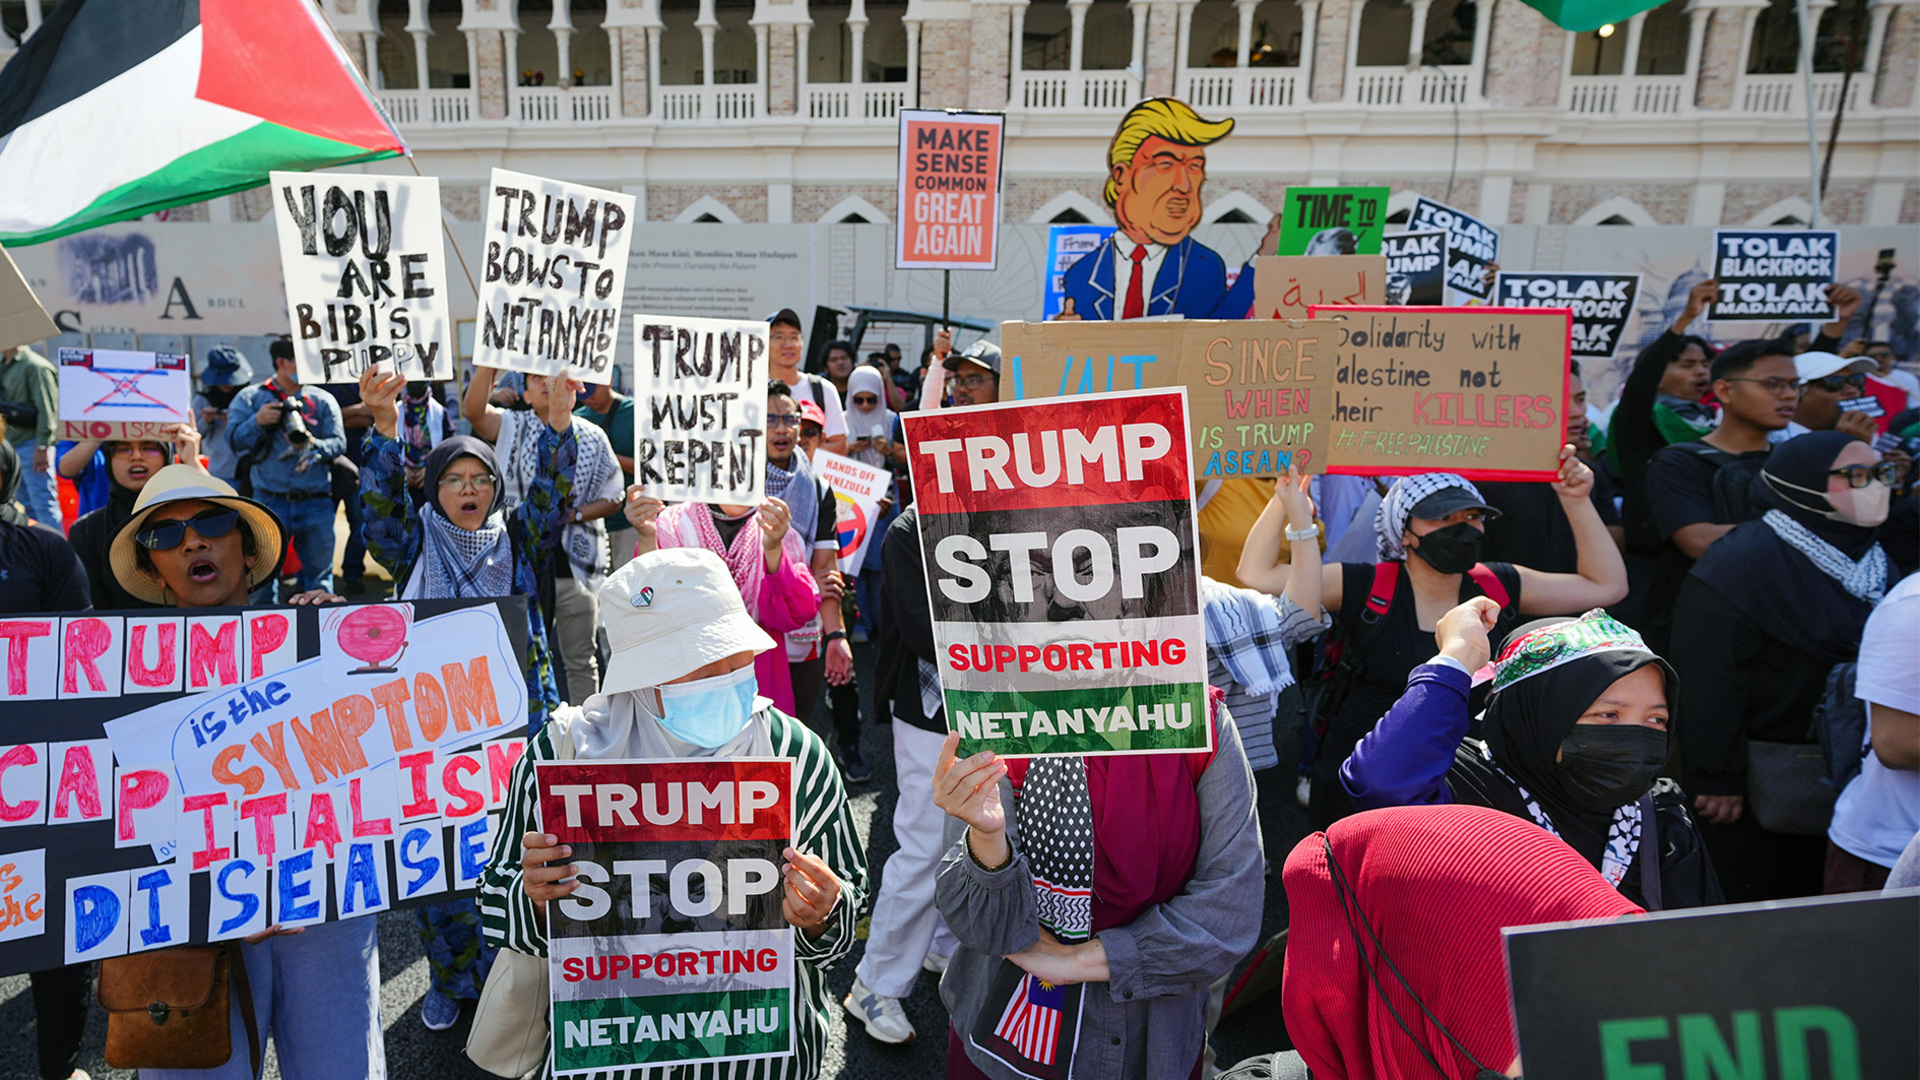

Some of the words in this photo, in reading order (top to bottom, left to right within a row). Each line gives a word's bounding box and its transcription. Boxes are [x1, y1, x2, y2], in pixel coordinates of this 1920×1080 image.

[917, 127, 990, 152] MAKE
[915, 153, 988, 174] SENSE
[914, 176, 987, 192] COMMON
[282, 185, 392, 260] YOU
[495, 186, 626, 260] TRUMP
[913, 192, 986, 223] GREAT
[1297, 194, 1352, 228] TIME
[1357, 198, 1377, 221] TO
[1417, 202, 1496, 249] TOLAK
[913, 224, 983, 255] AGAIN
[1721, 237, 1832, 258] TOLAK
[336, 253, 435, 300] ARE
[485, 241, 571, 291] BOWS
[573, 260, 615, 301] TO
[1720, 257, 1832, 277] BLACKROCK
[1504, 279, 1631, 300] TOLAK
[1715, 302, 1830, 315] MADAFAKA
[1719, 283, 1831, 303] TOLAK
[296, 302, 412, 344] BIBI'S
[1331, 314, 1446, 352] Solidarity
[1471, 324, 1521, 350] with
[320, 342, 440, 384] PUPPY
[642, 324, 765, 390] TRUMP
[1204, 337, 1319, 386] SINCE
[1459, 361, 1502, 388] not
[650, 392, 739, 431] MUST
[1225, 388, 1310, 419] WHEN
[1331, 391, 1384, 423] heir
[1413, 391, 1556, 430] KILLERS
[65, 420, 112, 439] NO
[1198, 426, 1224, 449] IS
[1236, 422, 1314, 447] TRUMP
[639, 428, 763, 492] REPENT
[825, 458, 858, 477] HANDS
[858, 470, 876, 482] OFF
[918, 422, 1172, 494] TRUMP
[1202, 449, 1312, 477] ASEAN?
[934, 525, 1180, 604] STOP
[0, 613, 289, 695] TRUMP
[948, 638, 1187, 673] SUPPORTING
[190, 710, 227, 748] is
[228, 681, 291, 725] the
[211, 655, 503, 796] SYMPTOM
[956, 702, 1192, 740] NETANYAHU
[549, 781, 780, 827] TRUMP
[73, 816, 491, 953] DISEASE
[557, 858, 780, 921] STOP
[562, 948, 778, 983] SUPPORTING
[564, 1007, 779, 1049] NETANYAHU
[1599, 1005, 1863, 1080] END
